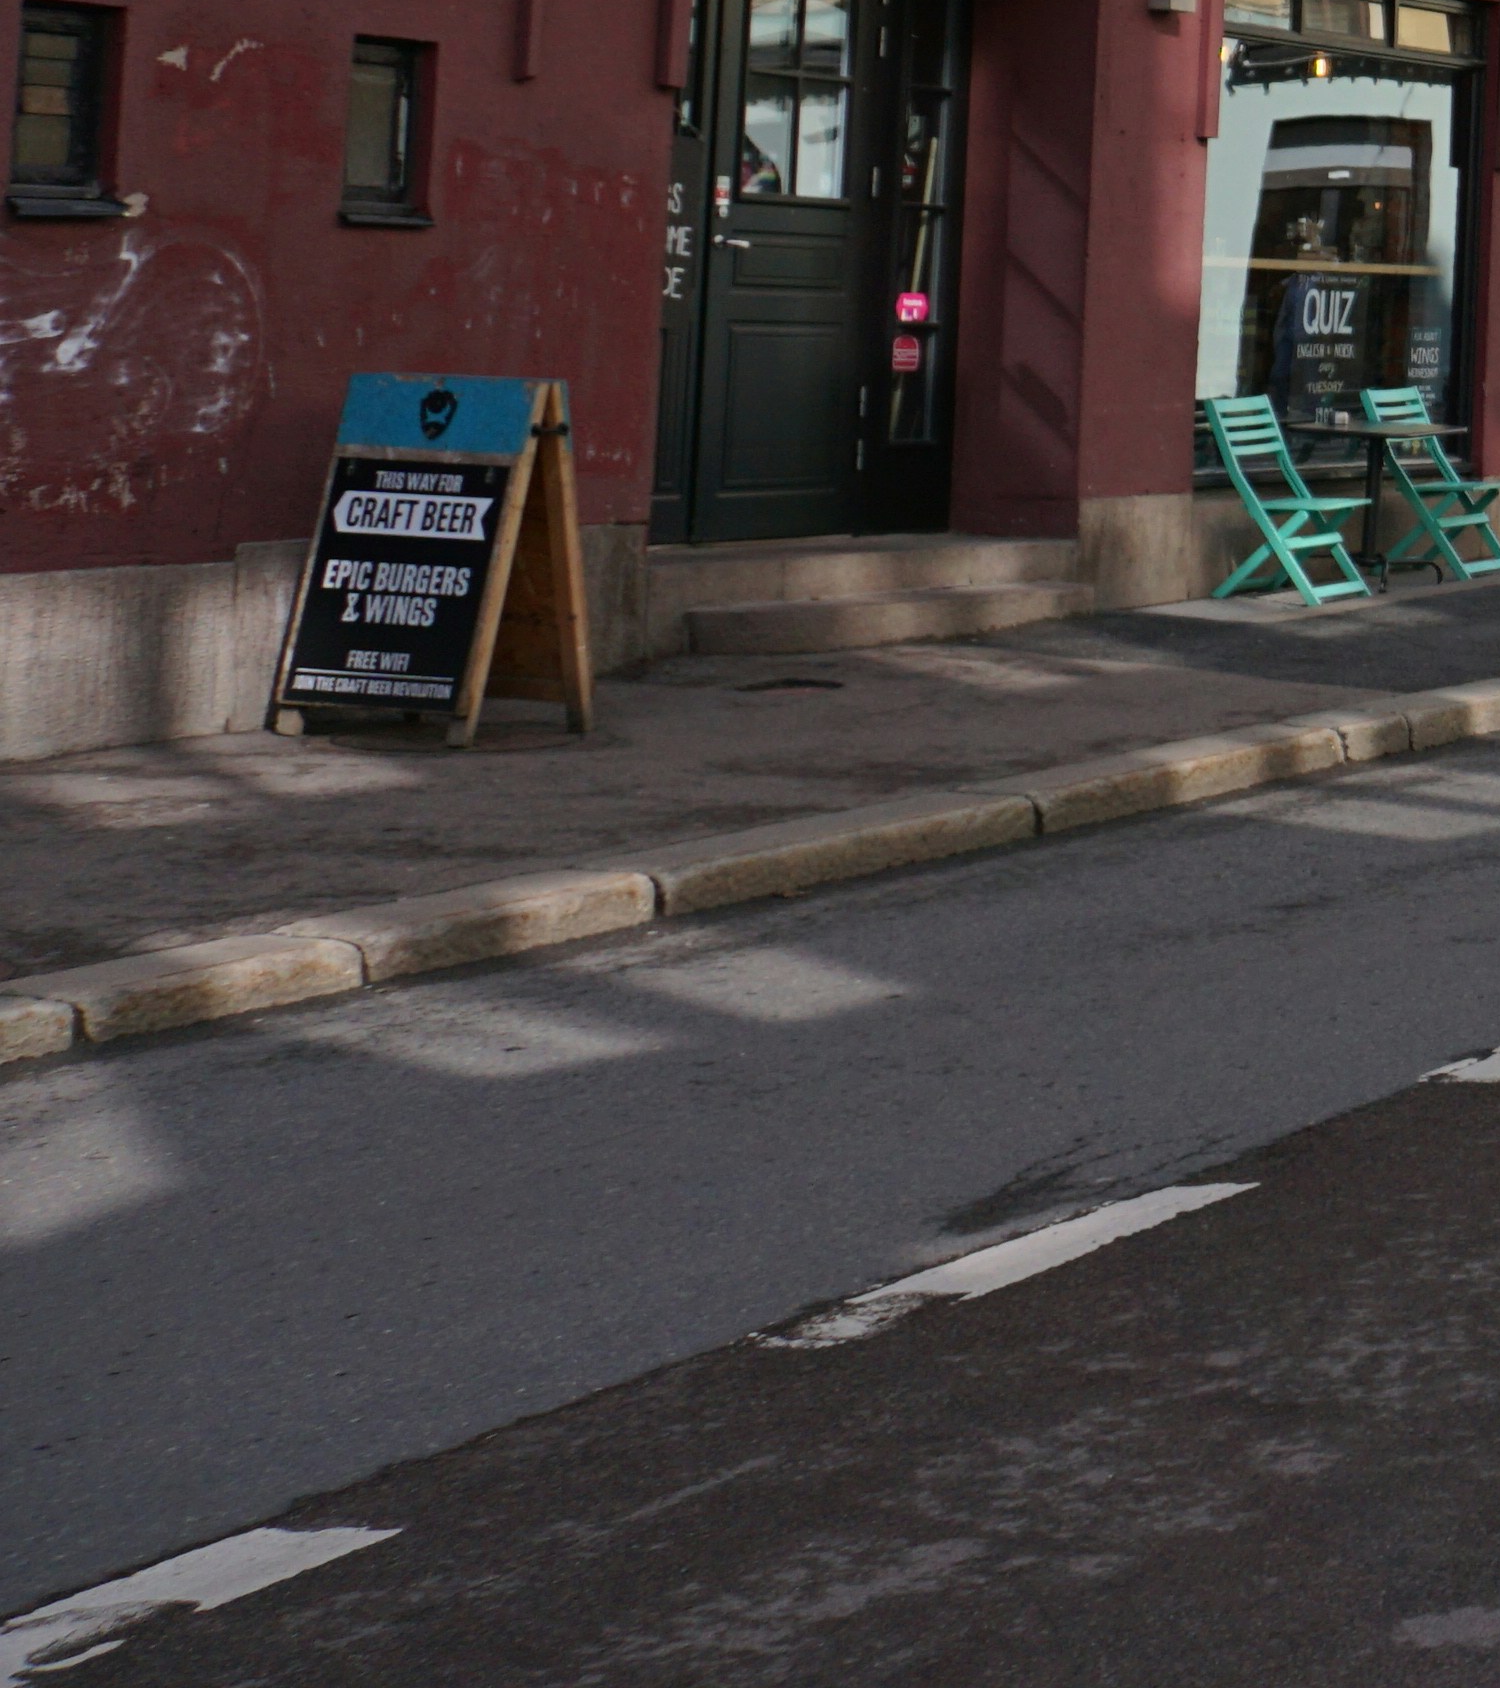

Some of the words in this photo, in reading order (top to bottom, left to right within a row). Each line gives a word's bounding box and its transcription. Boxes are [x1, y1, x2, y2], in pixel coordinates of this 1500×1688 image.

[1302, 288, 1355, 335] QUIZ
[1297, 343, 1325, 359] ENGLISH
[1334, 343, 1355, 358] NORSK
[1410, 347, 1440, 364] WINGS
[1307, 379, 1344, 394] TUESDAY
[376, 470, 405, 490] THIS
[407, 472, 437, 492] WAY
[437, 473, 464, 493] FOR
[346, 496, 419, 530] CRAFT
[420, 500, 477, 534] BEER
[321, 559, 374, 590] EPIC
[373, 562, 471, 597] BURGERS
[364, 594, 438, 627] WINGS
[345, 650, 379, 670] FREE
[379, 652, 411, 672] WIFI
[315, 675, 336, 692] THE
[335, 676, 367, 693] CRAFT
[367, 678, 392, 696] BEER
[392, 681, 453, 700] REVOLUTION
